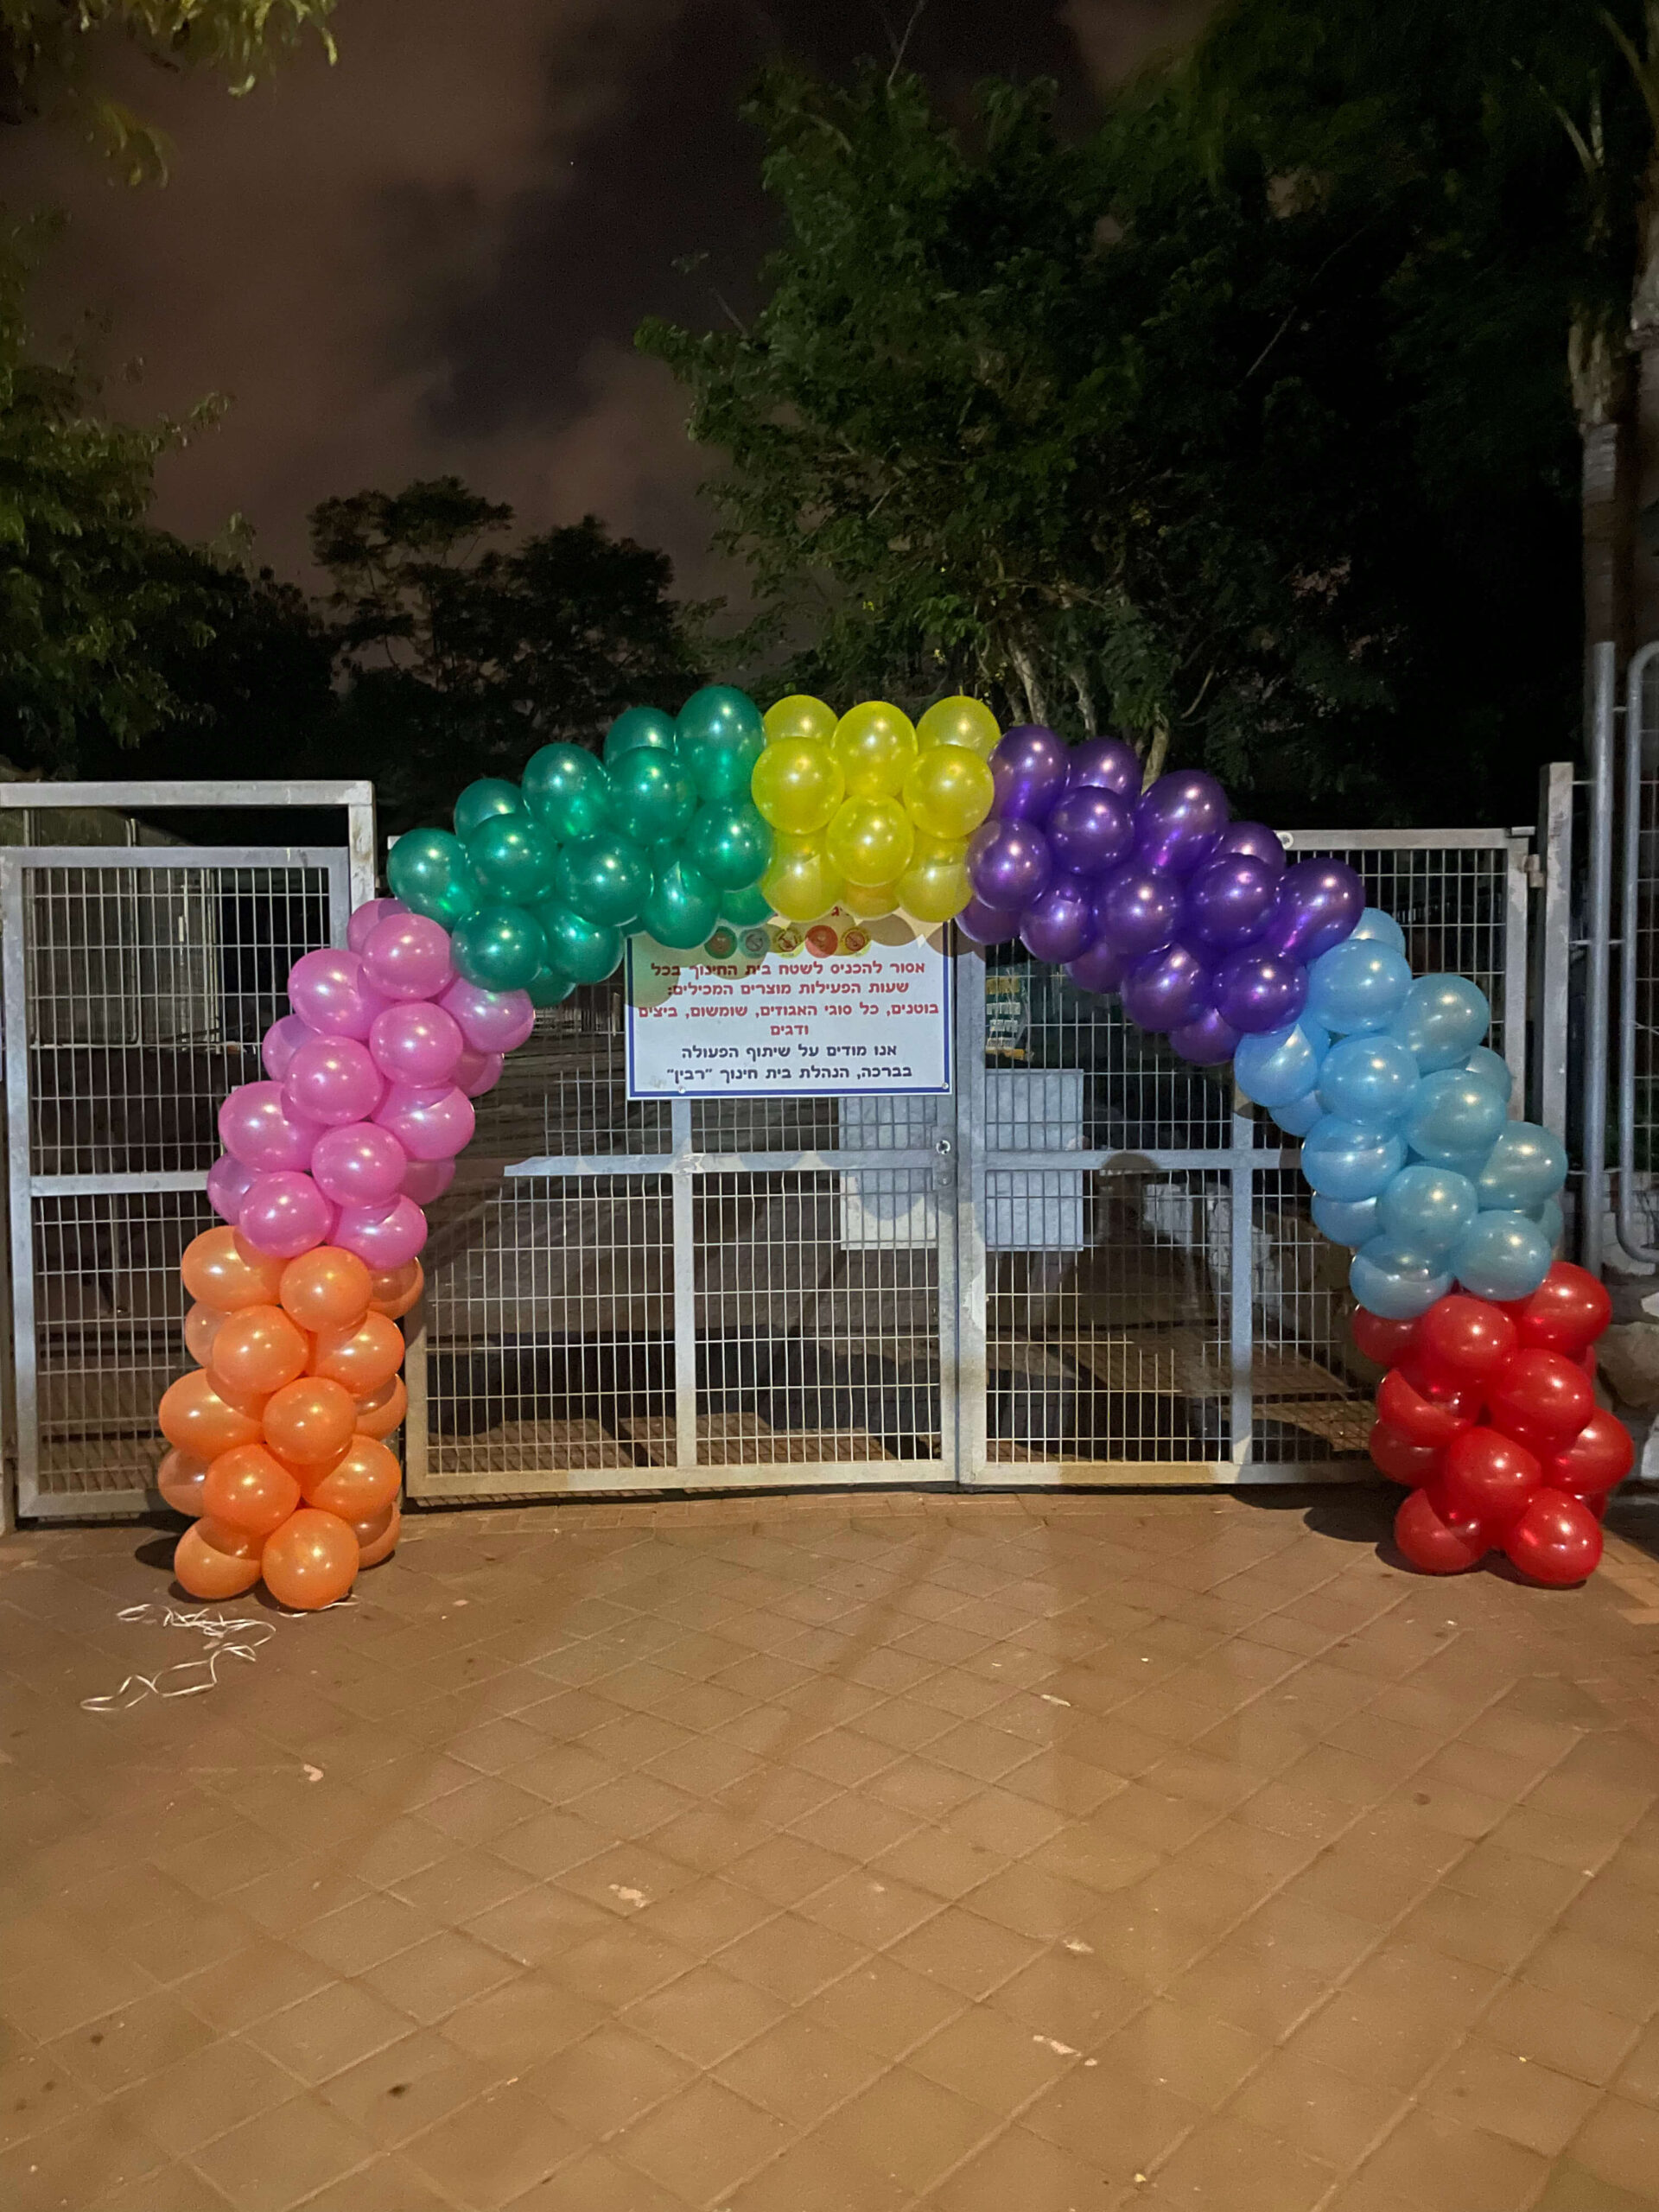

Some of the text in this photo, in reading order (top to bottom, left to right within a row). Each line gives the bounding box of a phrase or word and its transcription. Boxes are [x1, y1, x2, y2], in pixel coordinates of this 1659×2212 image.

[651, 960, 925, 980] אסור להכניס לשטח בית החינוך בכל
[668, 981, 909, 995] שעות הפעילות מוצרים המכילים:
[639, 1001, 938, 1019] בוטנים, כל סוגי האגוזים, שומשום, ביצים
[771, 1025, 809, 1036] ודגים
[682, 1044, 897, 1062] אנו מודים על שיתוף הפעולה
[720, 1069, 758, 1084] חינוך
[766, 1069, 791, 1078] בית
[799, 1065, 849, 1078] הנהלת
[857, 1066, 912, 1079] בברכה,
